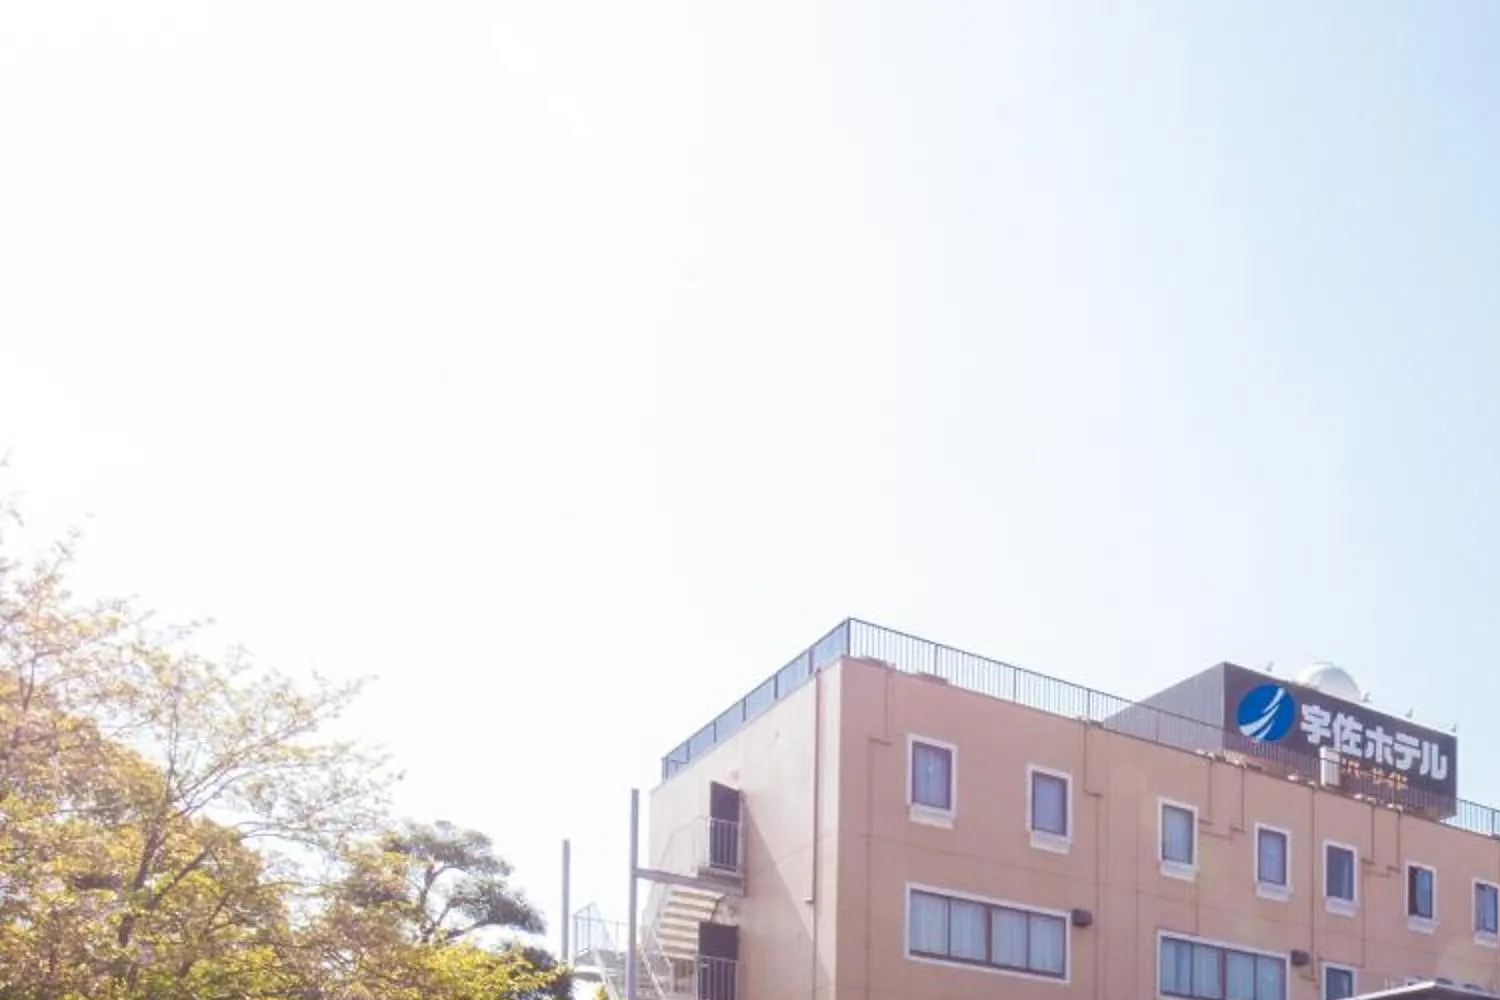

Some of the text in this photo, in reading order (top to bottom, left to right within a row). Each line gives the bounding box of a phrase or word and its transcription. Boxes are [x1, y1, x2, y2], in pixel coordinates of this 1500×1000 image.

[1301, 703, 1448, 780] 宇佐ホテル
